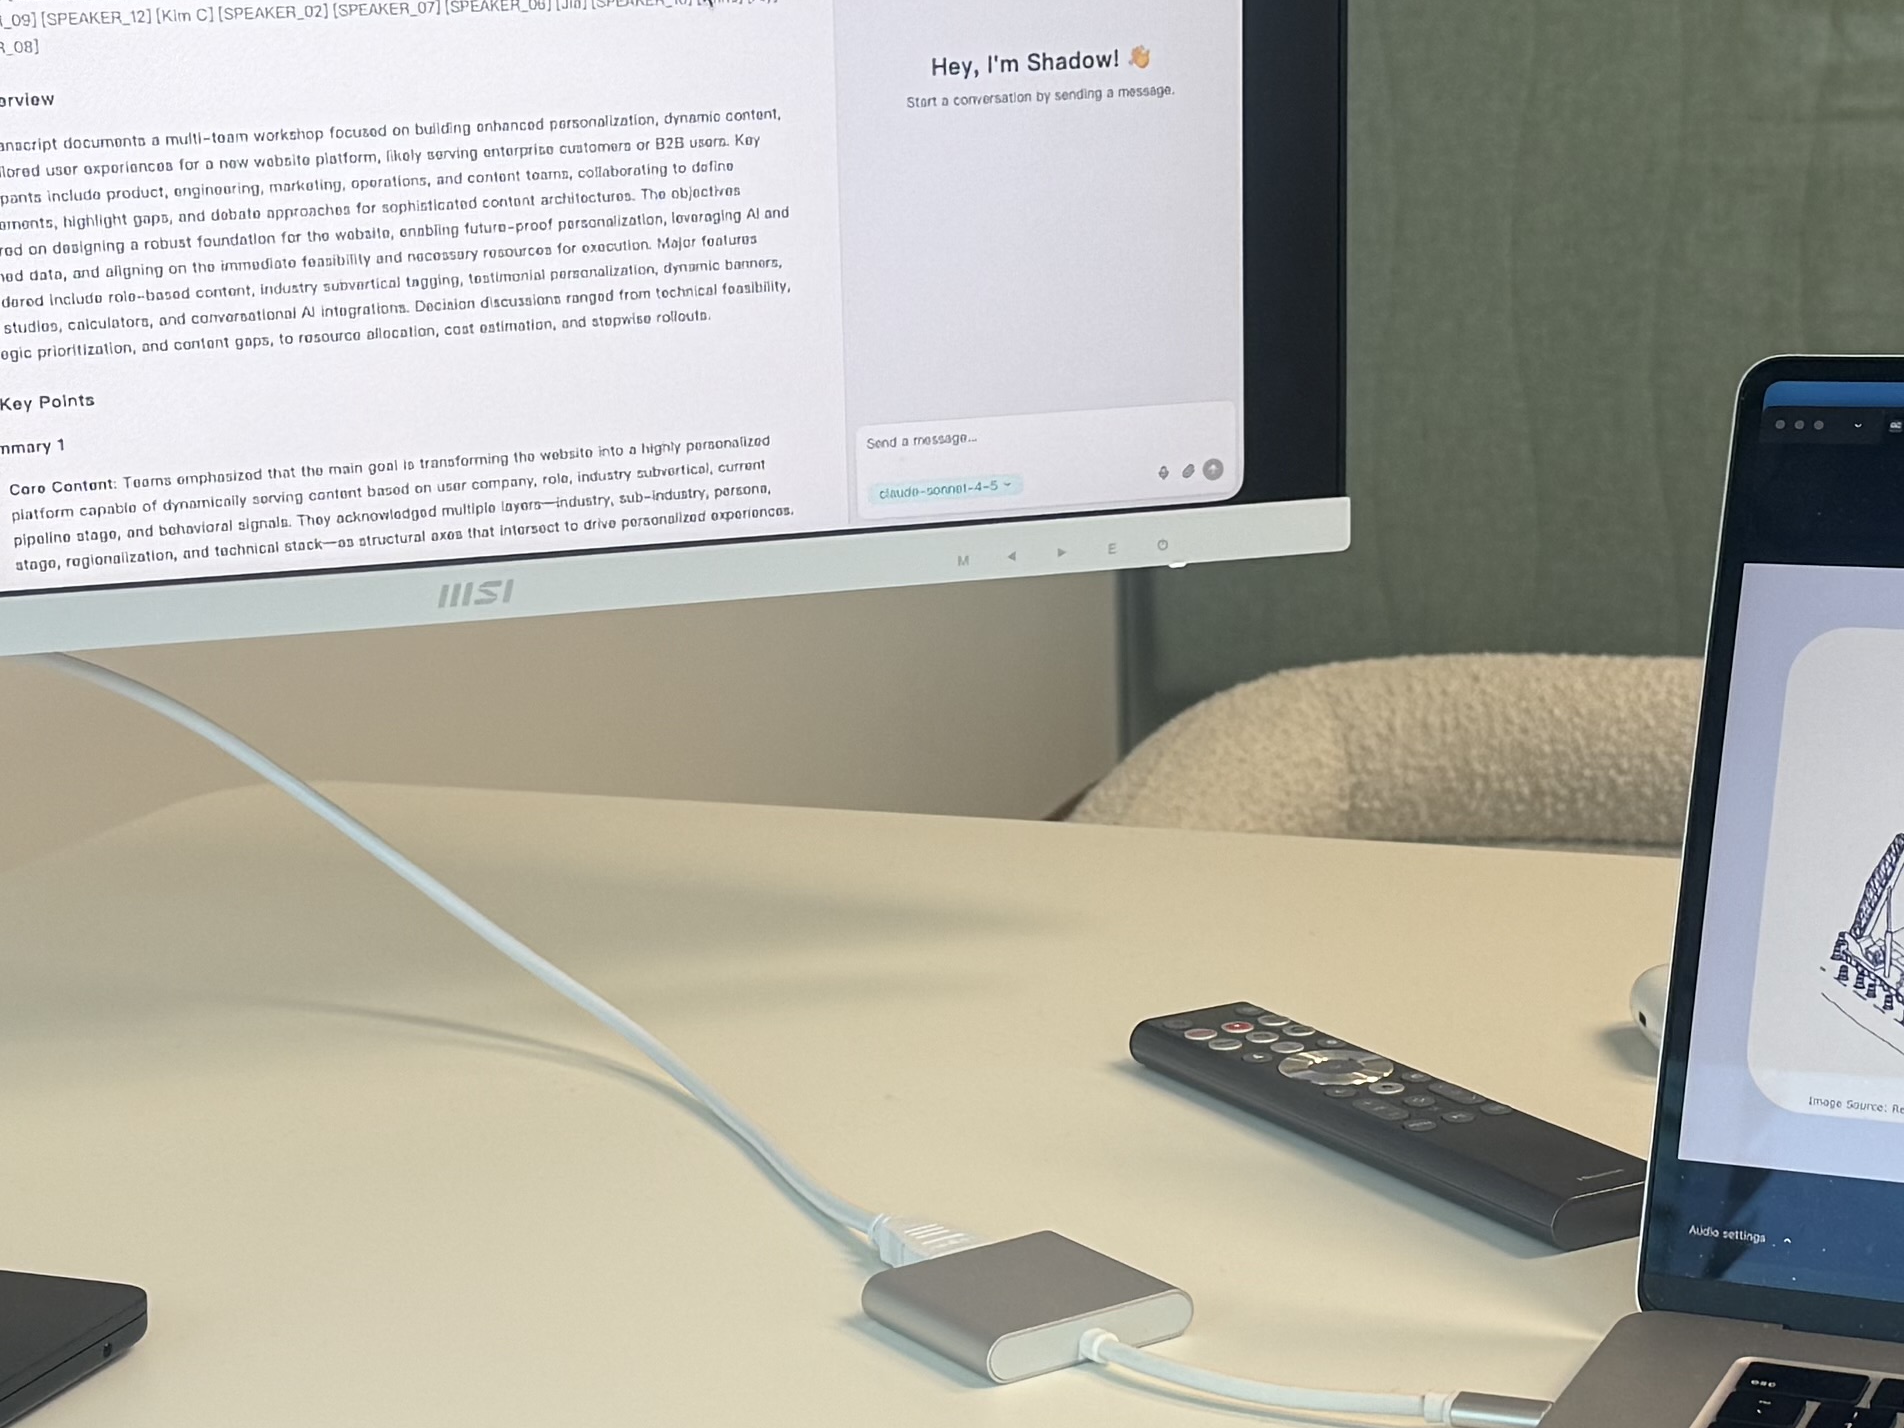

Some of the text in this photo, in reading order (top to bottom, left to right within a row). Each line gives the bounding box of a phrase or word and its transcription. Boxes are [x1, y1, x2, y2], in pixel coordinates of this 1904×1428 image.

[931, 48, 1119, 80] Hey, I'm Shadow!
[906, 85, 1175, 109] Start a conversation by sending a message.
[0, 394, 95, 413] Key Points
[57, 438, 64, 451] 1
[1108, 542, 1117, 555] E
[957, 555, 970, 567] M
[437, 578, 515, 609] MSI
[1808, 1096, 1842, 1110] Image
[1846, 1099, 1888, 1113] Source:
[1688, 1224, 1766, 1245] Audio settings
